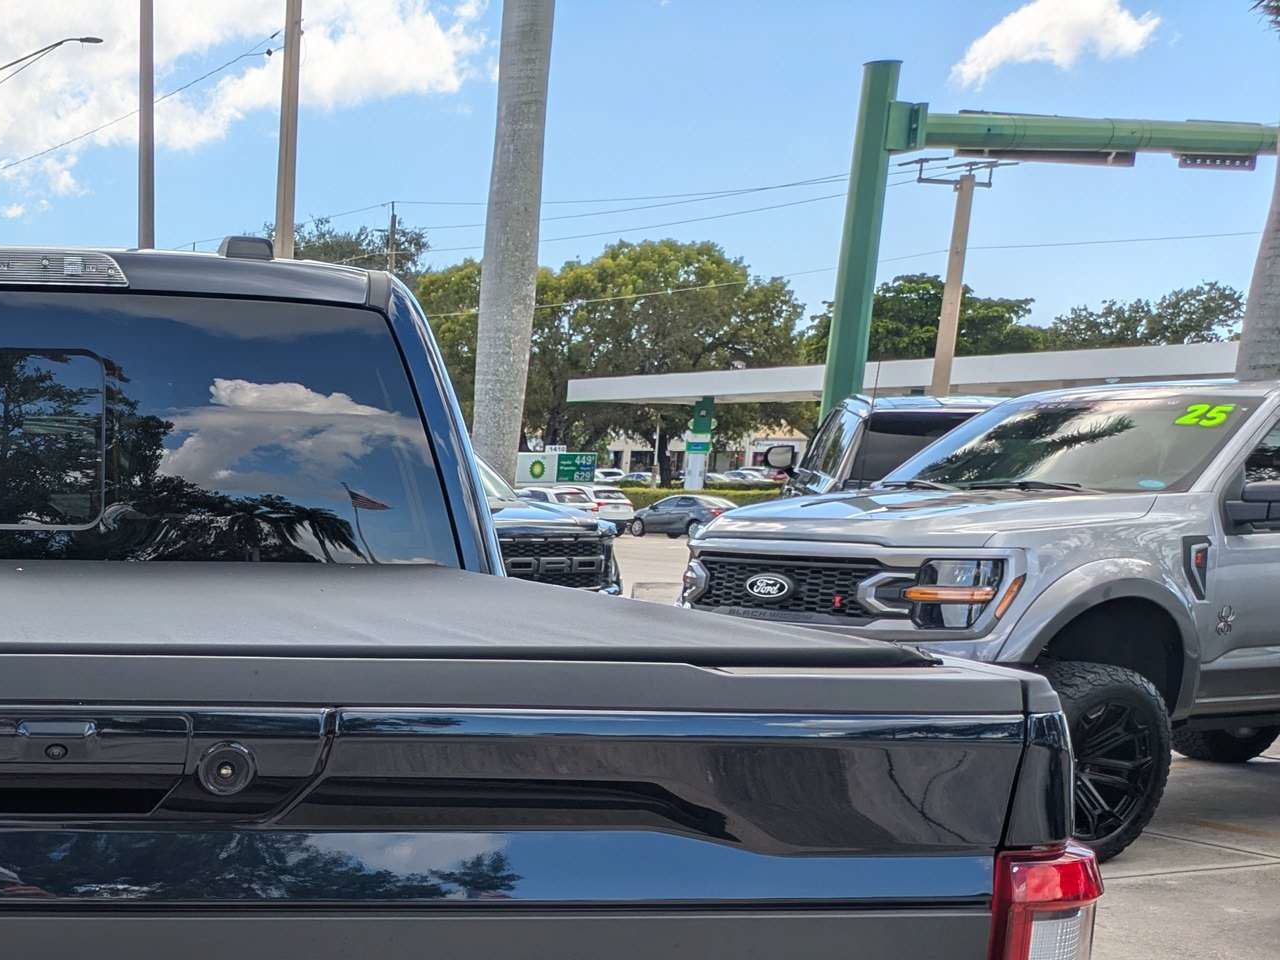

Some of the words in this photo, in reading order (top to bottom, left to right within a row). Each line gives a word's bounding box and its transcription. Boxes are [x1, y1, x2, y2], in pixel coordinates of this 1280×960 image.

[1174, 403, 1235, 427] 25
[504, 556, 605, 575] ORD
[753, 579, 780, 594] Ford
